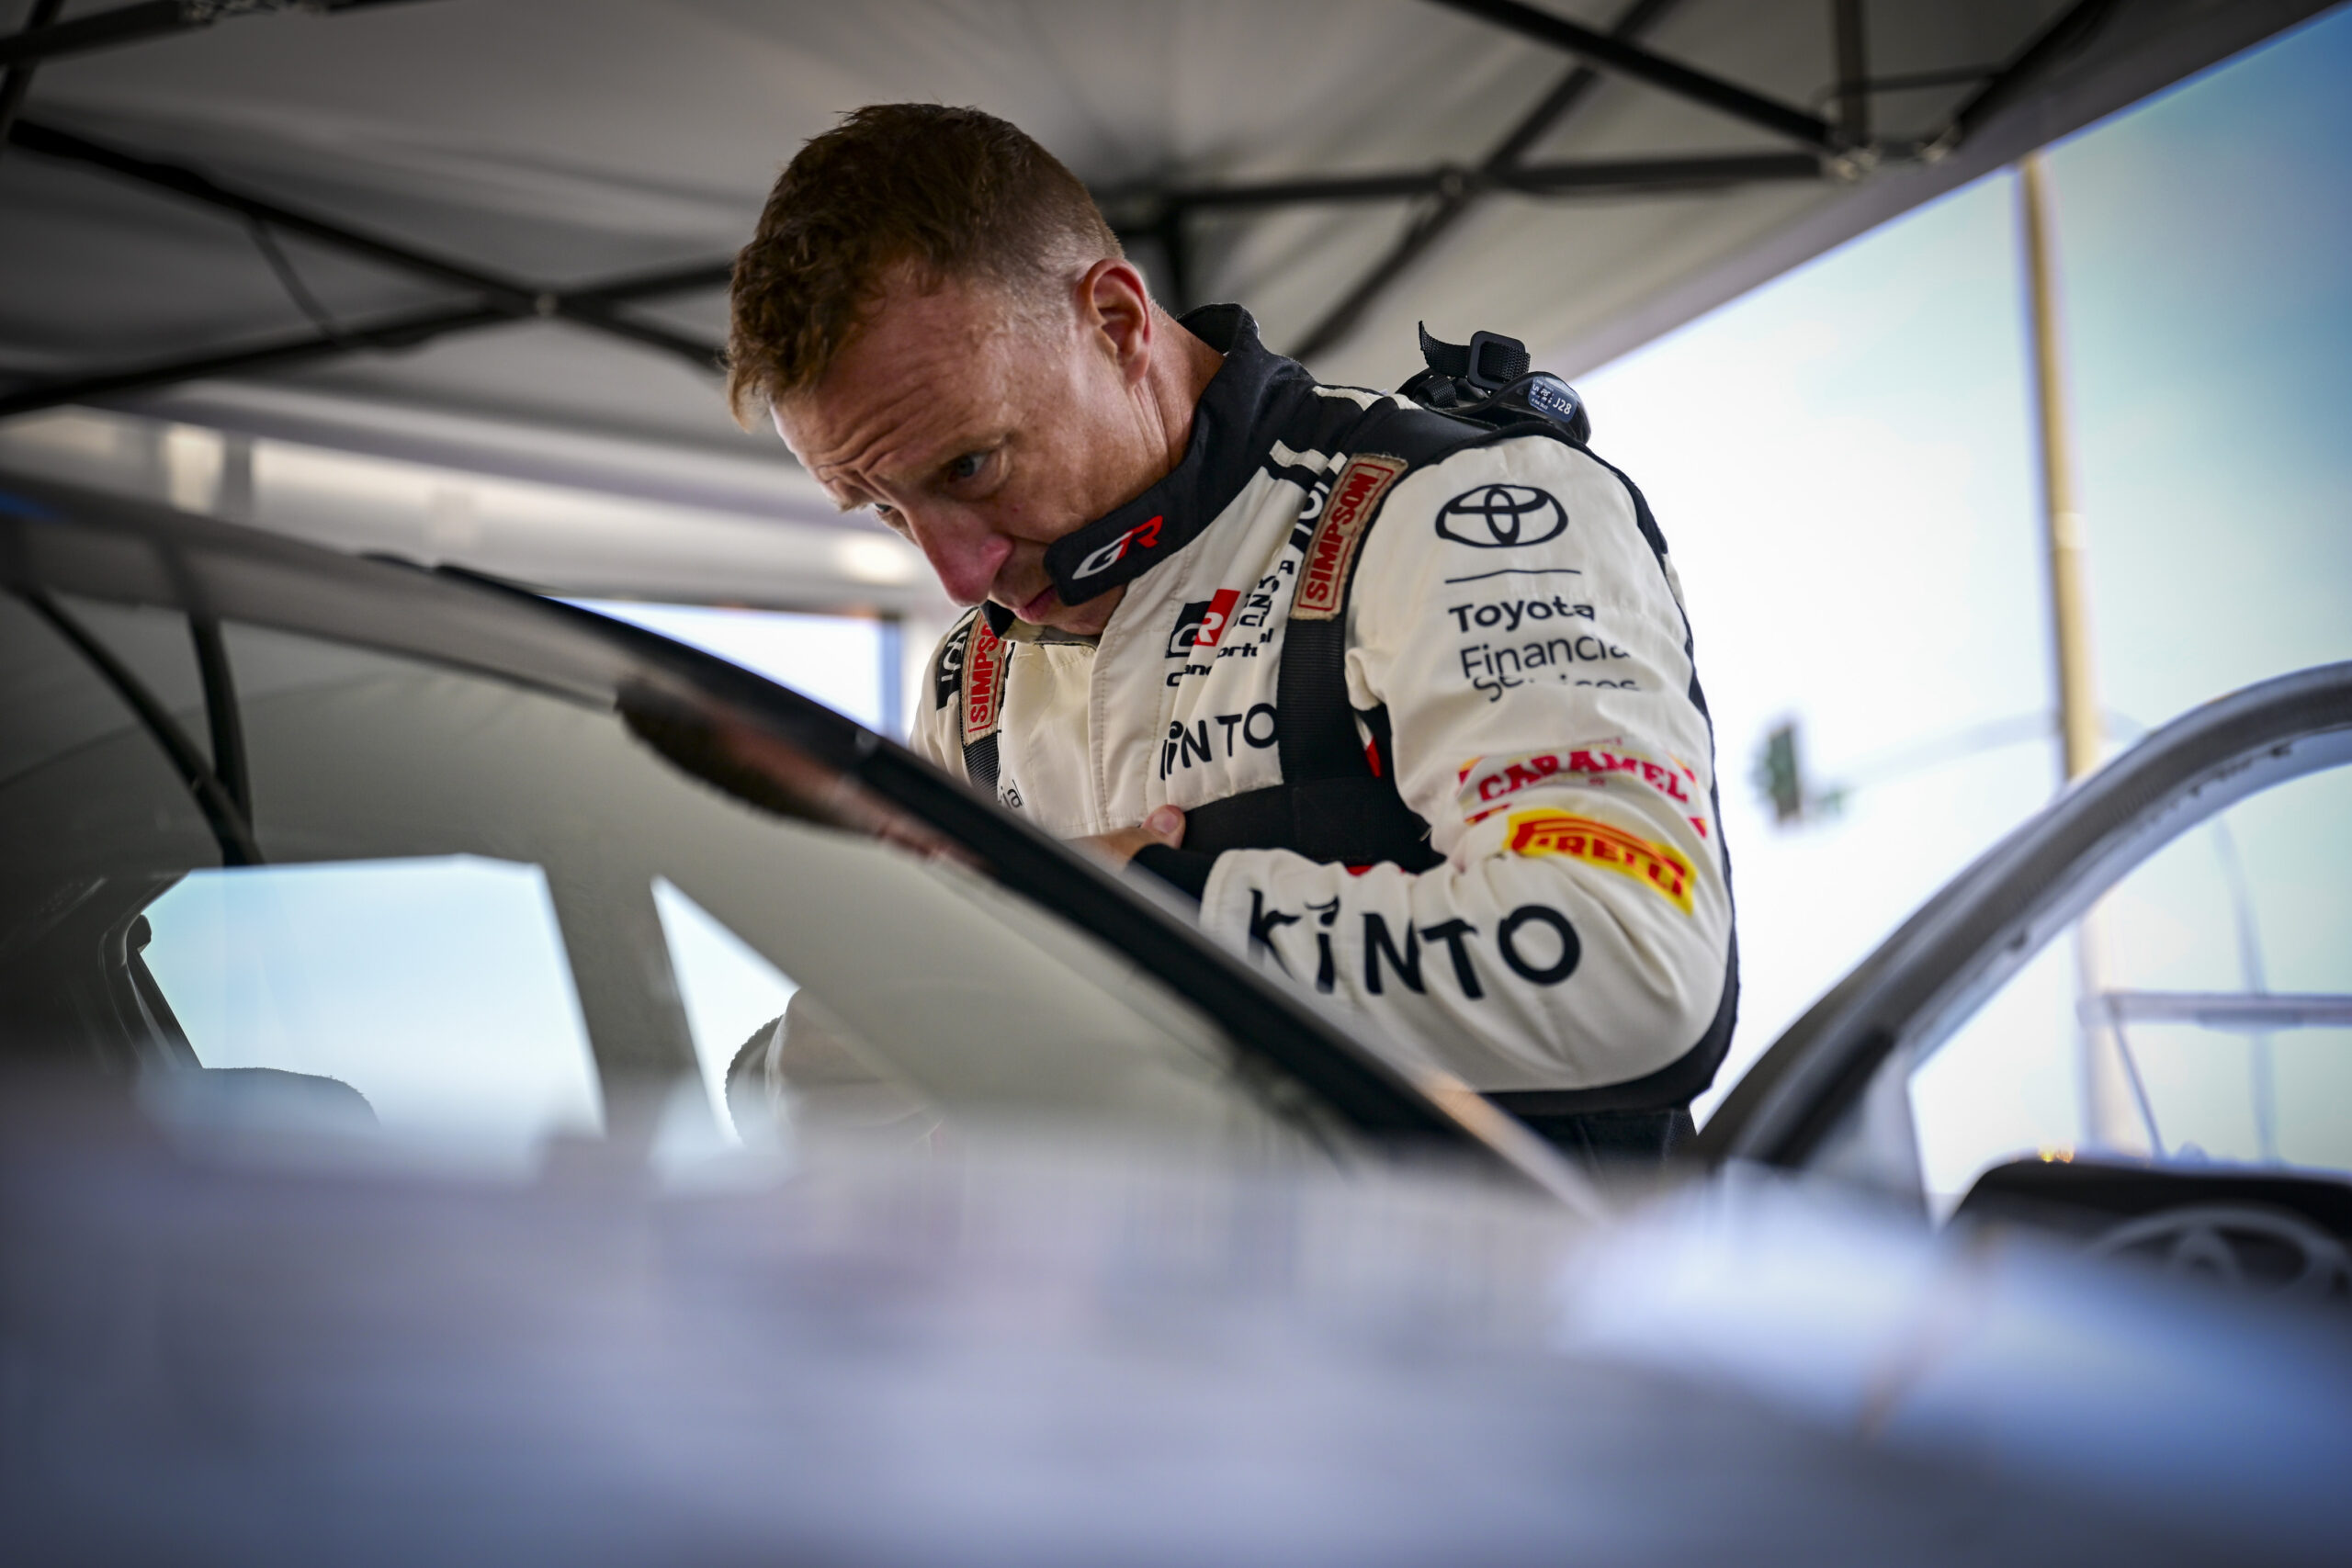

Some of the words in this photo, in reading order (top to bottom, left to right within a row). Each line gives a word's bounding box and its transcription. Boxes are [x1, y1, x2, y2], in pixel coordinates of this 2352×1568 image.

[1552, 397, 1572, 415] J28
[1306, 473, 1378, 602] SIMPSON
[1448, 595, 1595, 633] Toyota
[969, 623, 999, 723] SIMPS
[1461, 636, 1631, 679] Financia
